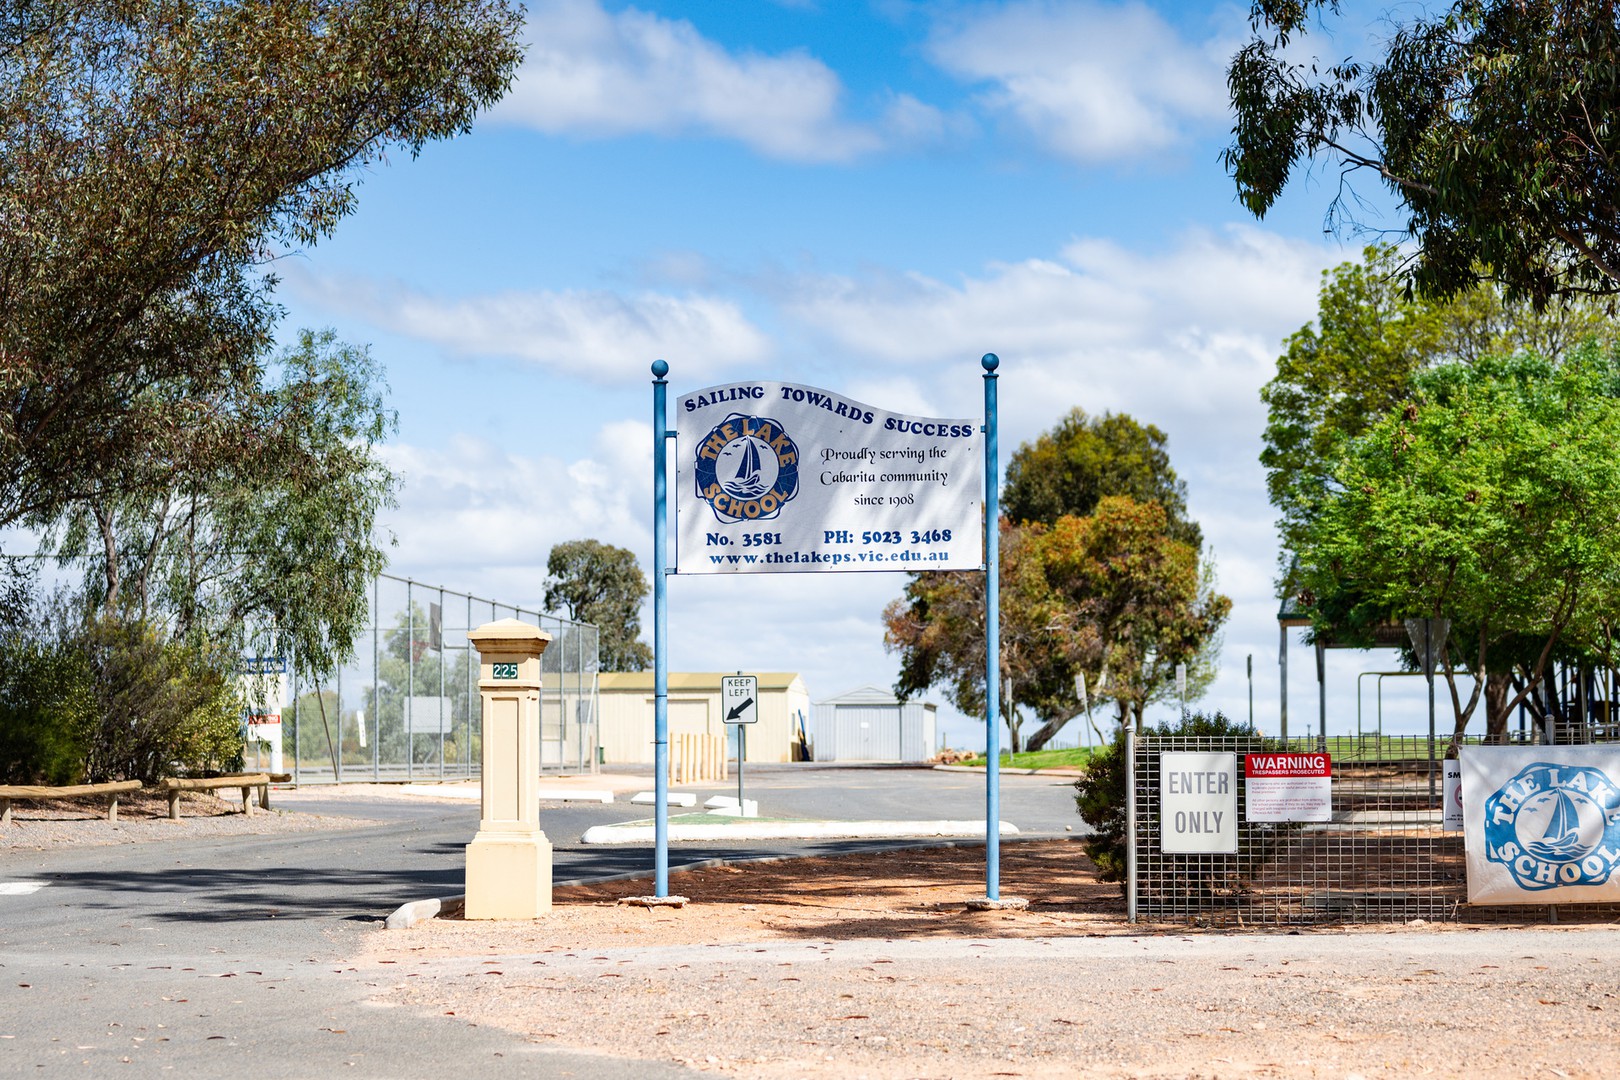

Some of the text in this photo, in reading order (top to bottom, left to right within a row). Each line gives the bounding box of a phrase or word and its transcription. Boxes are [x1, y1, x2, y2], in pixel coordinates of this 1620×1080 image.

[684, 386, 973, 438] SAILING TOWARDS SUCCESS
[700, 419, 797, 468] THE LAKE
[820, 445, 947, 465] Proudly serving the
[820, 469, 948, 486] Cabarita community
[703, 482, 789, 518] SCHOOL
[854, 492, 915, 508] since 1908
[706, 532, 782, 547] No. 3581
[824, 529, 952, 544] PH: 5023 3468
[709, 550, 949, 565] www.thelakeps.vic.edu.au
[494, 664, 518, 678] 225
[727, 678, 751, 687] KEEP
[729, 688, 750, 697] LEFT
[1252, 756, 1325, 769] WARNING
[1168, 772, 1229, 794] ENTER
[1492, 773, 1541, 826] THE
[1175, 811, 1223, 834] ONLY
[1498, 841, 1620, 884] SCHOOL
